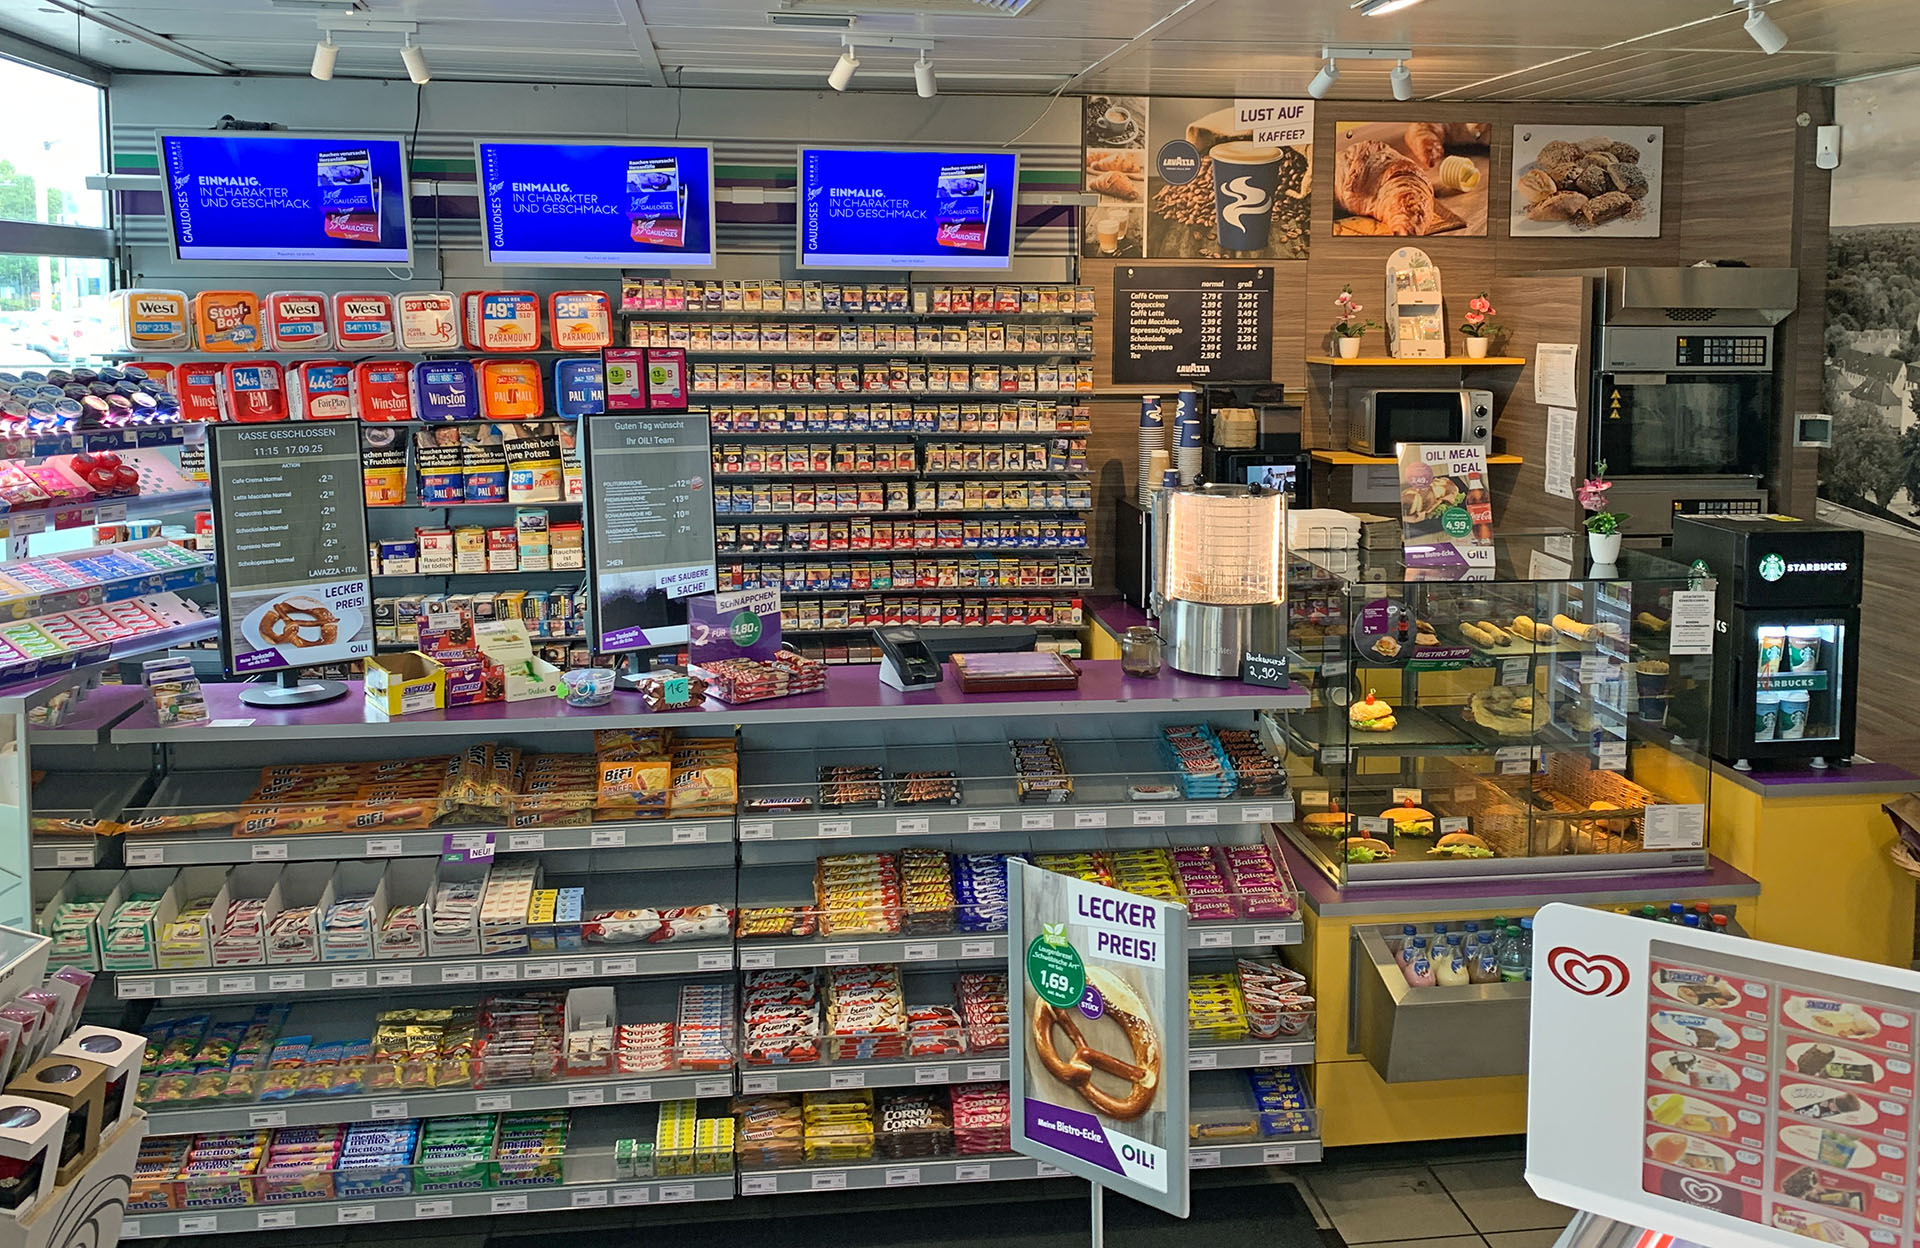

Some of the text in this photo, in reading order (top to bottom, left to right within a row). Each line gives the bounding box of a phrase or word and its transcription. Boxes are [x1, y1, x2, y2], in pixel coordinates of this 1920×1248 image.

[1241, 105, 1305, 123] LUST AUF
[1258, 129, 1305, 143] KAFFEE?
[1163, 156, 1195, 167] LAVAZZA
[198, 176, 262, 187] EINMALIG.
[200, 187, 289, 198] IN CHARAKTER
[512, 182, 573, 193] EINMALIG.
[829, 188, 886, 198] EINMALIG.
[200, 198, 310, 209] UND GESCHMACK
[513, 193, 598, 204] IN CHARAKTER
[829, 198, 909, 209] IN CHARAKTER
[513, 203, 618, 215] UND GESCHMACK
[829, 208, 927, 219] UND GESCHMACK
[181, 191, 194, 243] GAULOISES
[494, 197, 505, 247] GAULOISES
[808, 202, 819, 250] GAULOISES
[1201, 280, 1253, 289] normal groß
[1130, 292, 1147, 301] Caffè
[139, 303, 176, 314] West
[283, 304, 317, 315] West
[347, 303, 382, 315] West
[1130, 301, 1165, 310] Cappuccino
[209, 306, 249, 320] Stopf-
[1130, 309, 1147, 318] Caffè
[216, 317, 241, 329] Box
[1130, 318, 1147, 326] Latte
[1148, 318, 1179, 326] Macchiato
[1130, 326, 1182, 335] Espresso/Doppio
[488, 332, 532, 342] PARAMOUNT
[562, 332, 605, 342] PARAMOUNT
[1130, 335, 1166, 343] Schokolade
[1130, 343, 1173, 352] Schokopresso
[1130, 352, 1141, 360] Tee
[1176, 363, 1210, 373] LAVAZZA
[250, 392, 268, 408] L&M
[429, 392, 466, 405] Winston
[494, 391, 532, 402] PALL MALL
[569, 391, 585, 401] PALL
[318, 399, 347, 408] FairPlay
[371, 397, 407, 410] Winston
[615, 421, 684, 430] Guten Tag wünscht
[238, 428, 336, 441] KASSE GESCHLOSSEN
[506, 440, 539, 452] Rauchen
[626, 437, 636, 445] Ihr
[637, 437, 652, 445] OIL!
[254, 444, 323, 456] 11:15 17.09.25
[508, 450, 550, 459] Ihre Potenz
[1425, 449, 1480, 461] OIL! MEAL
[1453, 462, 1481, 474] DEAL
[1446, 521, 1466, 530] 4,99
[1467, 550, 1488, 559] OIL!
[309, 568, 340, 577] LAVAZZA
[1787, 562, 1848, 572] STARBUCKS
[661, 569, 709, 585] EINE SAUBERE
[325, 583, 364, 598] LECKER
[677, 583, 706, 595] SACHE!
[336, 597, 365, 610] PREIS!
[720, 592, 776, 609] SCHNÄPPCHEN-
[754, 602, 776, 614] BOX!
[735, 623, 754, 634] 1,80
[695, 625, 726, 646] 2 FÜR
[350, 644, 368, 654] OIL!
[436, 650, 463, 658] SNICKERS
[1415, 648, 1470, 658] BISTRO TIPP
[1246, 652, 1286, 666] Bockwurst
[452, 683, 480, 693] SNICKERS
[1757, 679, 1814, 688] STARBUCKS
[403, 684, 433, 695] SNICKERS
[604, 767, 633, 781] BiFi
[674, 770, 700, 784] BiFi
[357, 811, 384, 826] BiFi
[554, 817, 587, 825] CHICKEN
[246, 817, 277, 832] BiFi
[472, 848, 491, 857] NEU!
[1250, 896, 1284, 905] Balisto
[1078, 894, 1156, 929] LECKER
[1193, 902, 1228, 911] Balisto
[1098, 932, 1156, 961] PREIS!
[1040, 970, 1069, 990] 1,69
[1086, 992, 1094, 1003] 2
[850, 1005, 875, 1014] bueno
[1081, 1001, 1100, 1012] STÜCK
[761, 1022, 791, 1032] bueno
[883, 1119, 926, 1130] CORNY
[962, 1113, 1002, 1125] CORNY
[1038, 1118, 1104, 1143] Meine Bistro-Ecke.
[199, 1139, 241, 1149] mentos
[1122, 1144, 1155, 1169] OIL!
[423, 1179, 482, 1191] mentos
[499, 1175, 555, 1187] mentos
[265, 1189, 326, 1201] mentos
[344, 1183, 404, 1196] mentos
[186, 1195, 247, 1207] mentos
